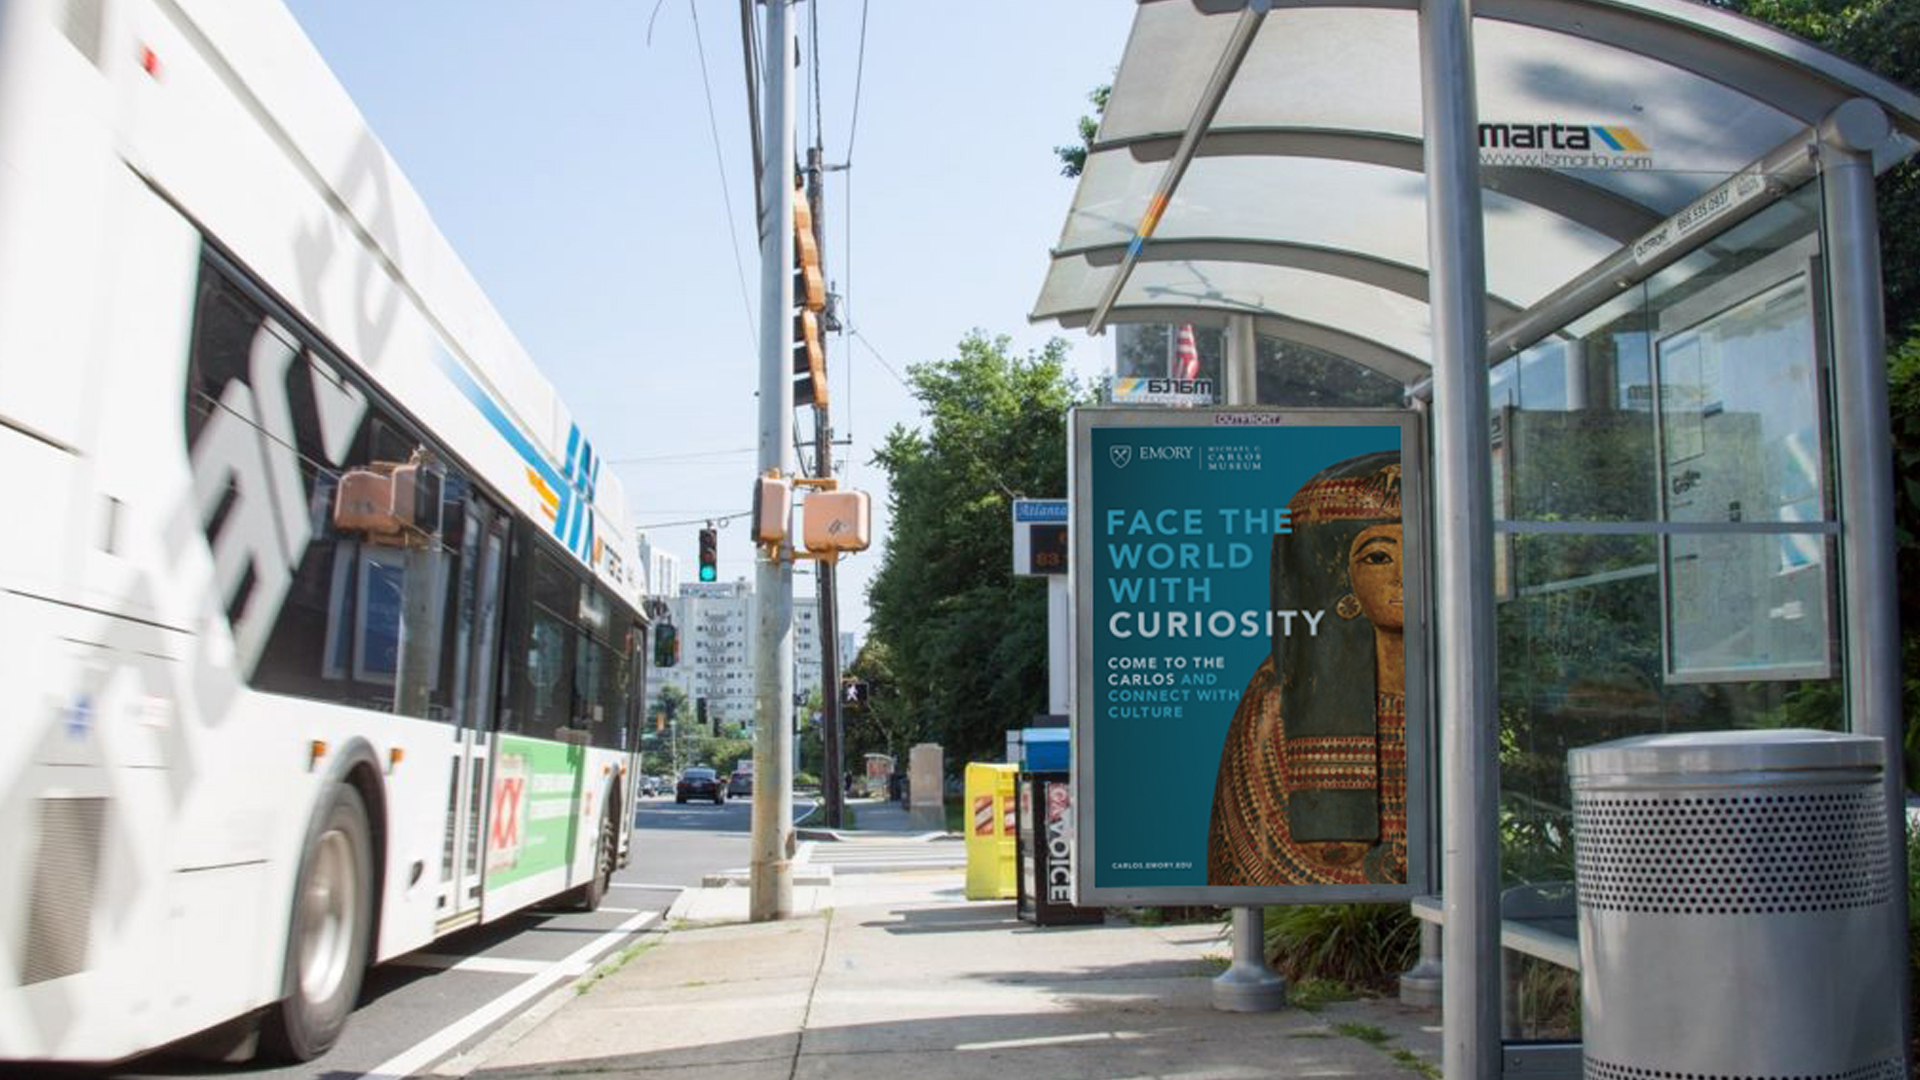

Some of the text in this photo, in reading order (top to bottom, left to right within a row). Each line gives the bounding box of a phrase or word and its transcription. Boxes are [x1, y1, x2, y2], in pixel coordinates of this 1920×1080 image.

[1479, 124, 1590, 150] marta
[1480, 153, 1652, 168] www.itsmarta.com
[1140, 446, 1193, 460] EMORY
[1207, 453, 1263, 462] CARLOS
[1207, 462, 1263, 471] MUSEUM
[1107, 508, 1293, 535] FACE THE
[1108, 543, 1253, 569] WORLD
[1108, 577, 1210, 603] WITH
[1109, 609, 1325, 638] CURIOSITY
[1107, 656, 1224, 669] COME TO THE
[1107, 673, 1217, 686] CARLOS AND
[1107, 689, 1240, 702] CONNECT WITH
[1107, 706, 1183, 718] CULTURE
[1111, 861, 1193, 870] CARLOS.EMORY.EDU
